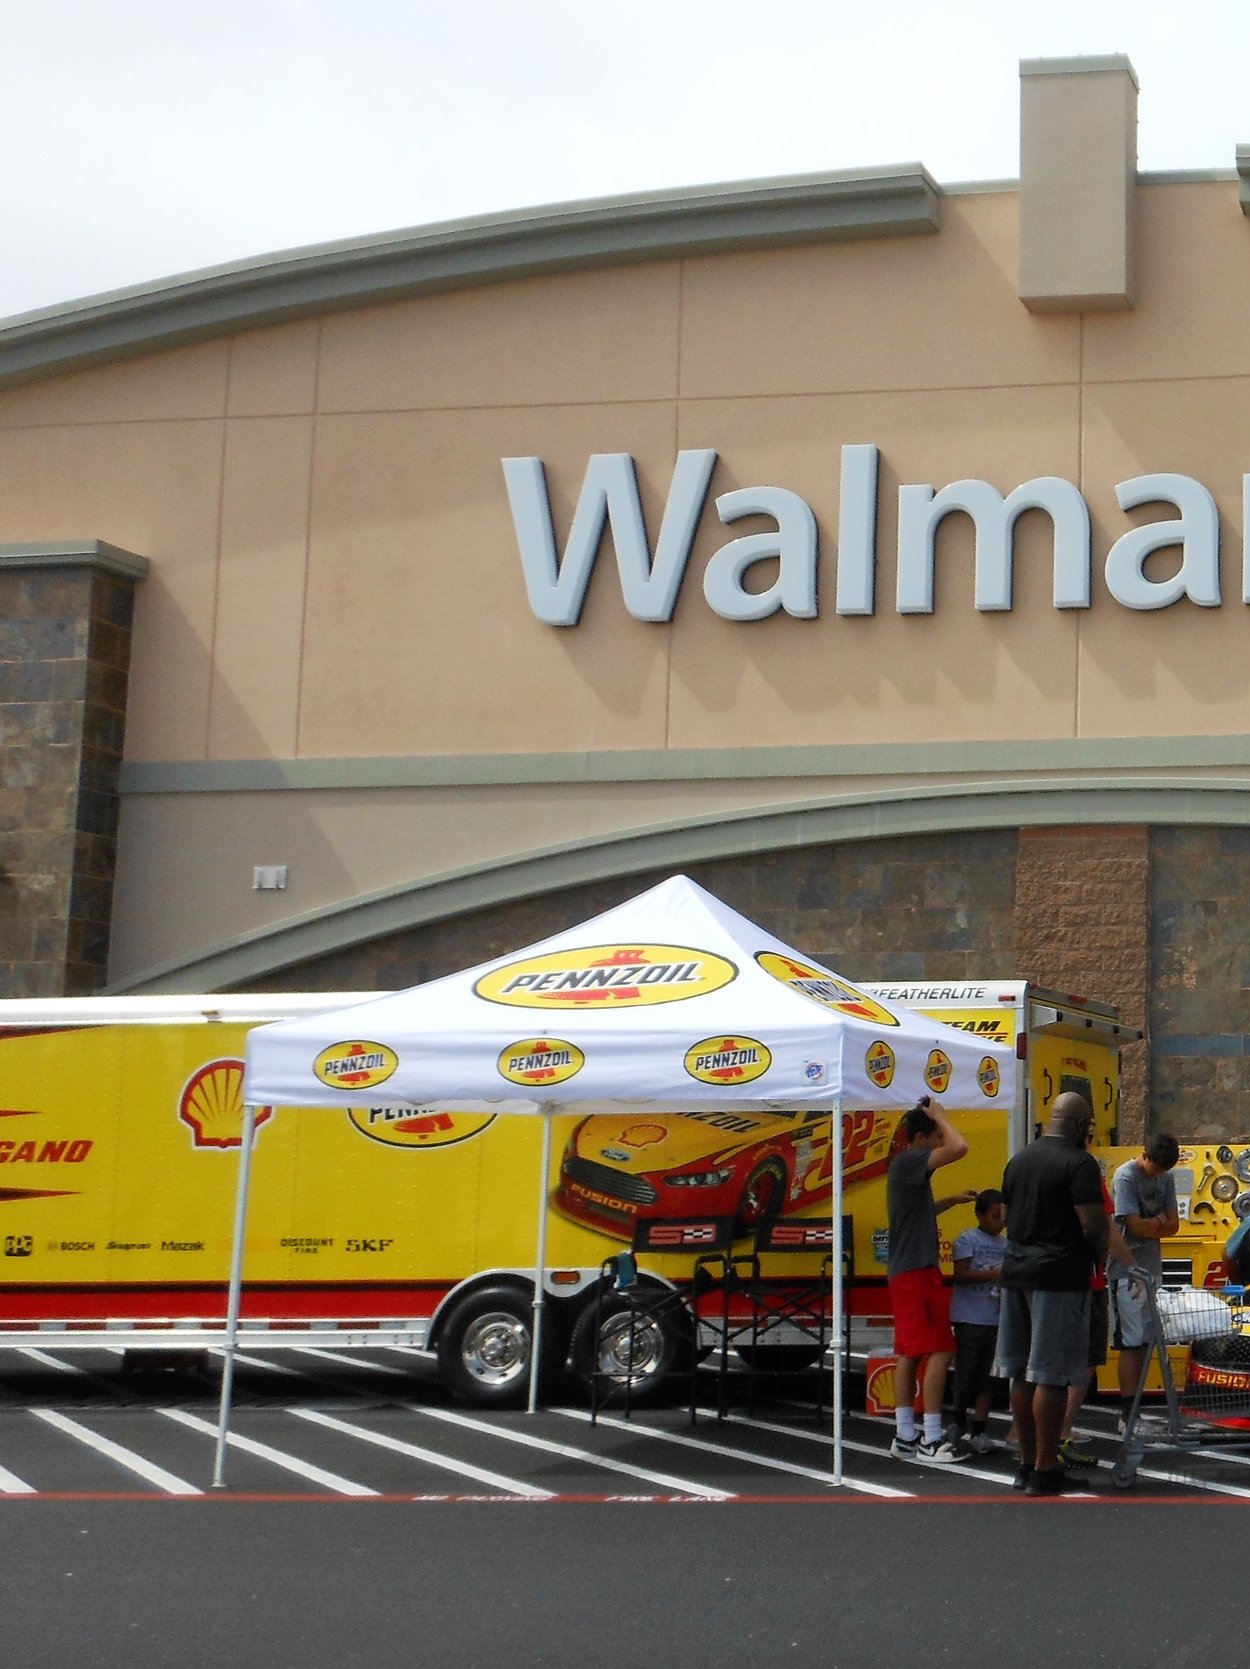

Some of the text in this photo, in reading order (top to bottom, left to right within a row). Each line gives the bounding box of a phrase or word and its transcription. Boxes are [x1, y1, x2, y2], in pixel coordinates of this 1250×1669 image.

[501, 962, 700, 994] PENNZOIL
[878, 987, 987, 1000] FEATHERLITE
[324, 1052, 386, 1075] PENNZOIL
[507, 1050, 572, 1073] PENNZOIL
[695, 1048, 758, 1071] PENNZOIL
[61, 1242, 95, 1251] BOSCH
[162, 1241, 204, 1251] Mazak
[280, 1239, 333, 1247] DISCOUNT
[345, 1240, 394, 1252] SKF
